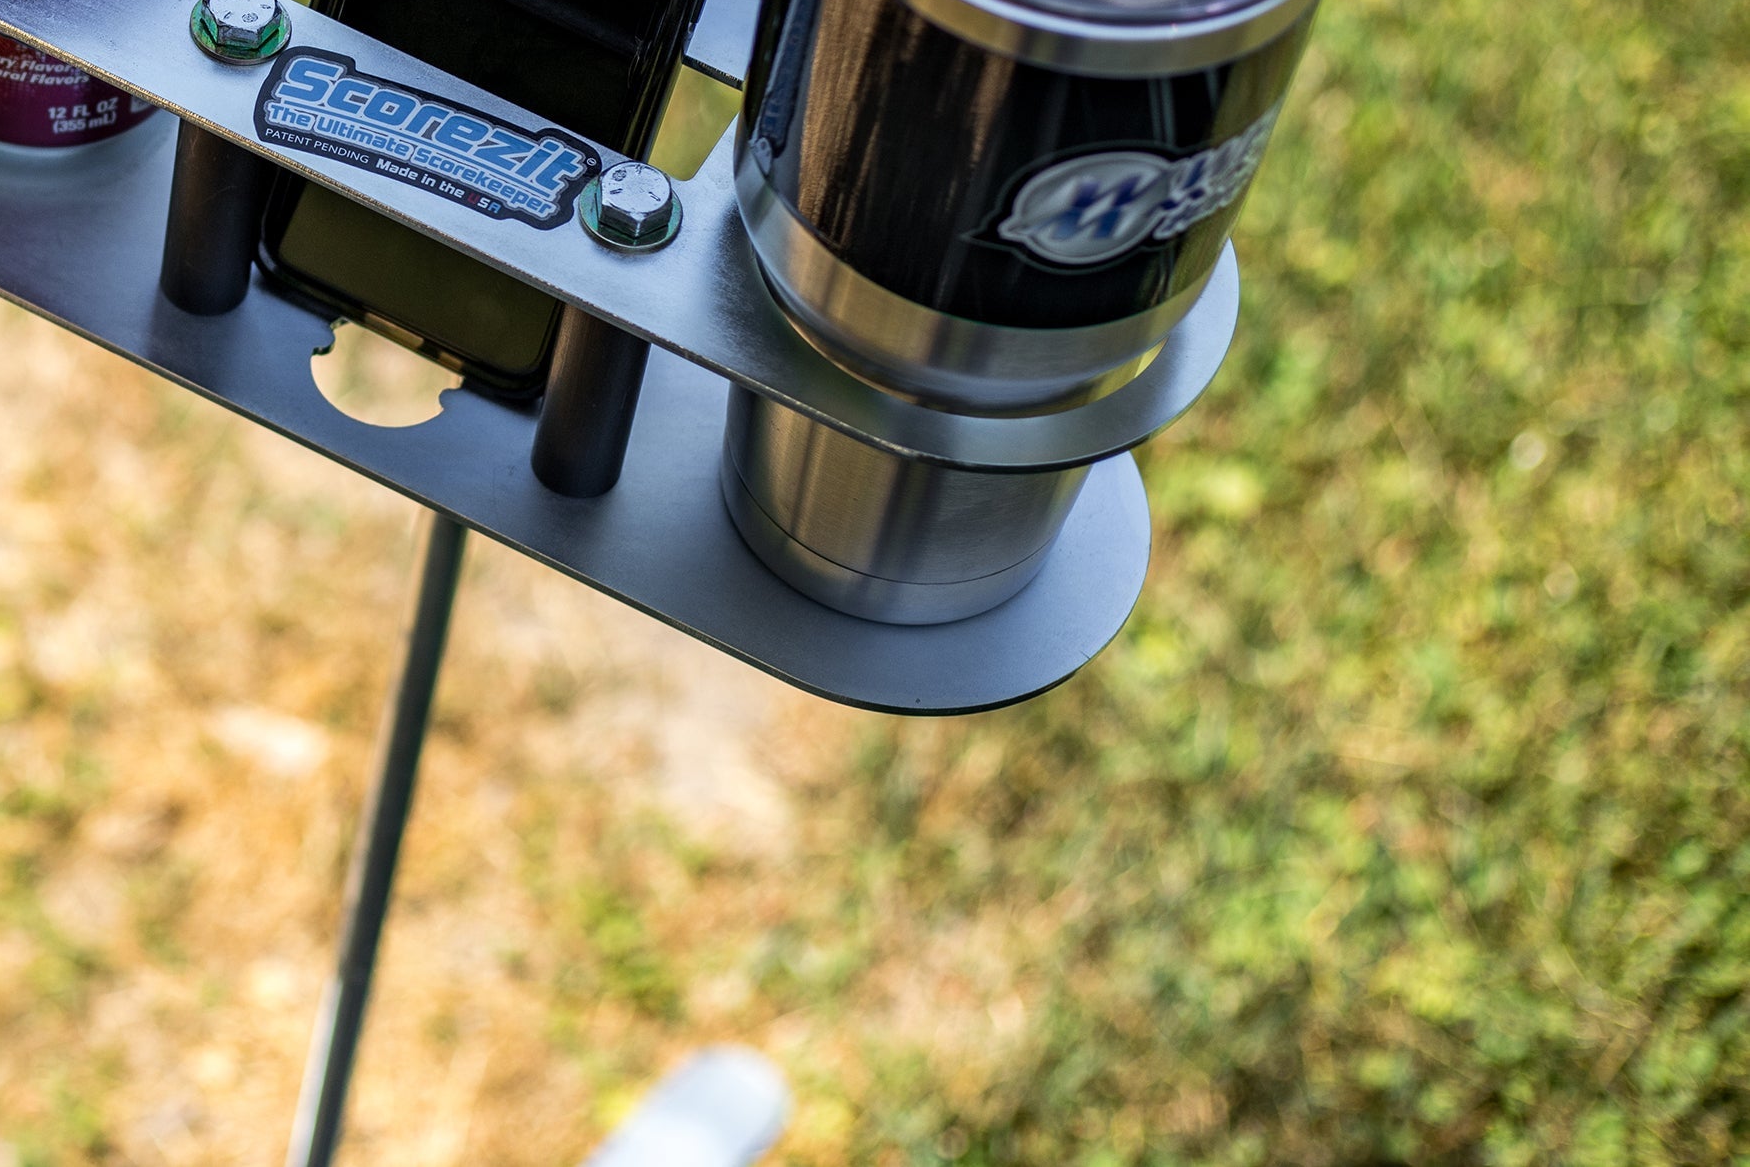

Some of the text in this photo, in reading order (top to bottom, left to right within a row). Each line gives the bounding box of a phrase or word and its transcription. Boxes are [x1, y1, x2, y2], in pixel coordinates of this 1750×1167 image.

[29, 72, 91, 85] Flavors
[48, 97, 119, 120] 12 FL OZ
[52, 110, 117, 134] (355 mL)
[275, 57, 582, 192] Scorezit
[265, 127, 502, 214] PATENT PENDING Made in the USA
[269, 103, 555, 215] The Ultimate Scorekeeper
